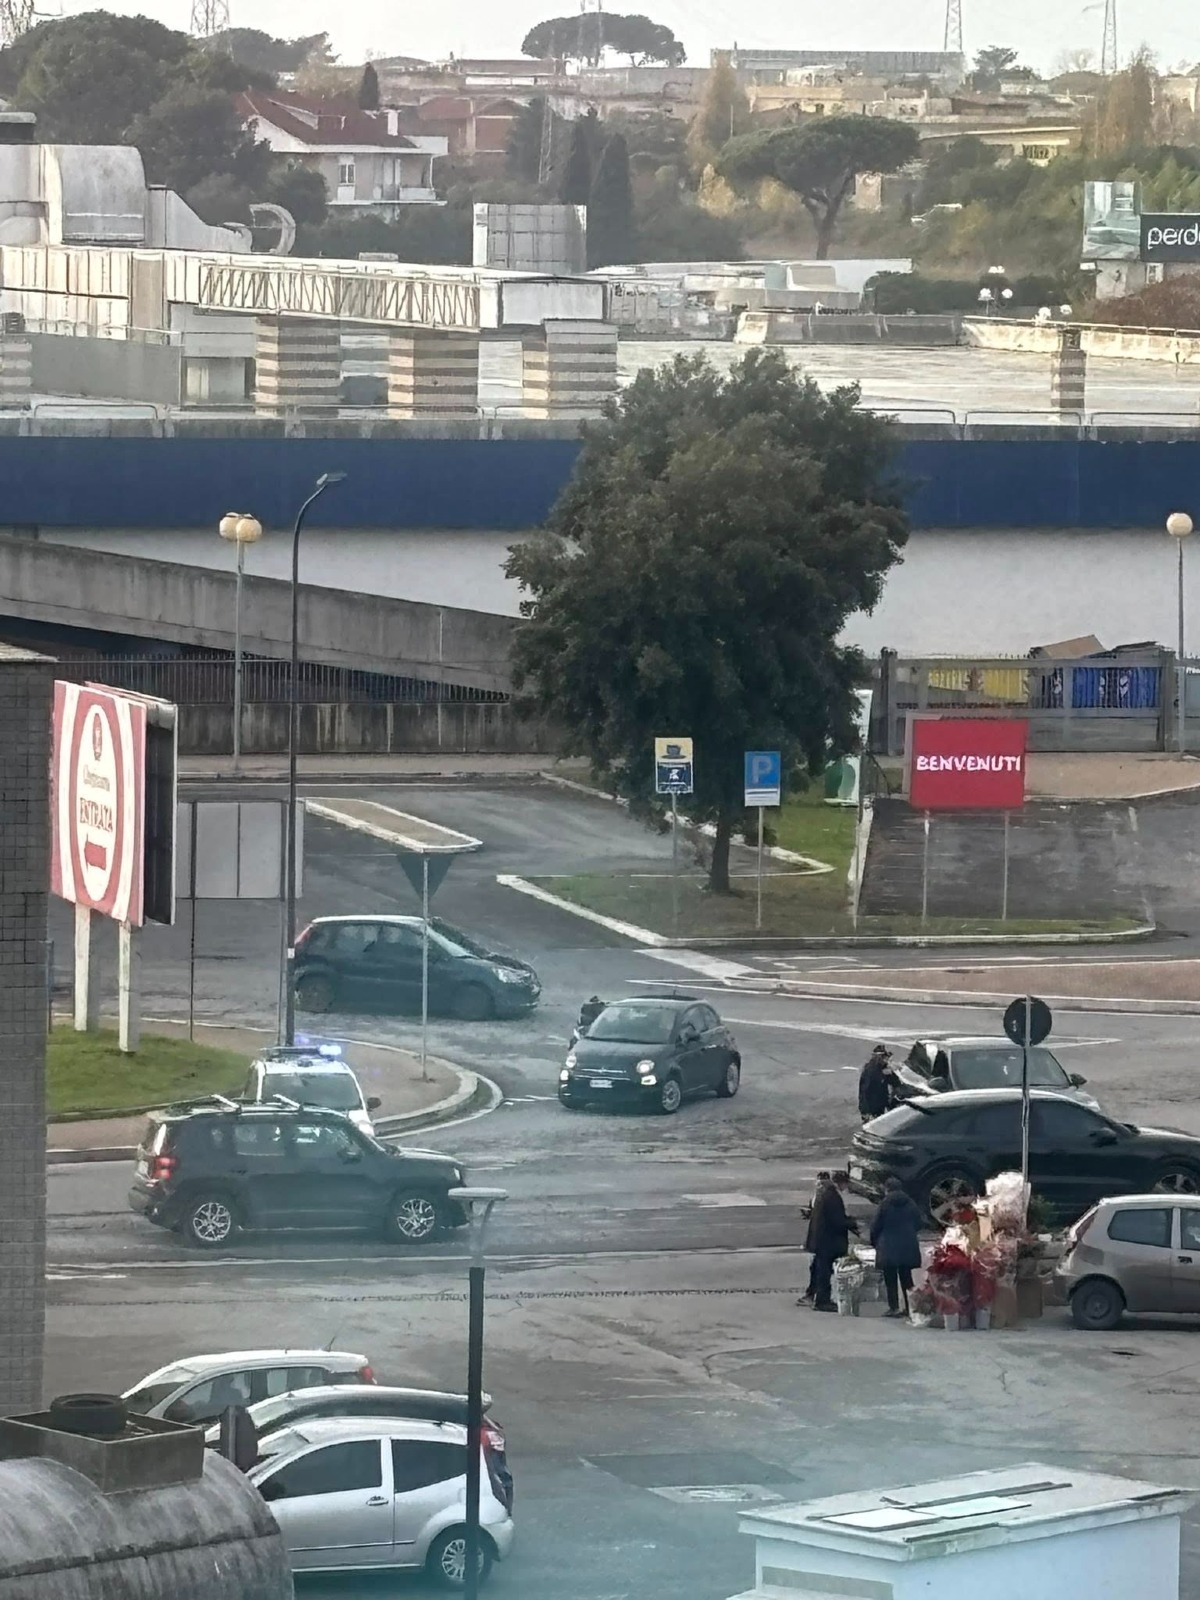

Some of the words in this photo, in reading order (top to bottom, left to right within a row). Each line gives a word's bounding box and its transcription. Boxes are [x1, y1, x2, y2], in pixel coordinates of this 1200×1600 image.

[1148, 223, 1200, 250] perd
[751, 755, 772, 784] P
[916, 755, 1021, 772] BENVENUTI
